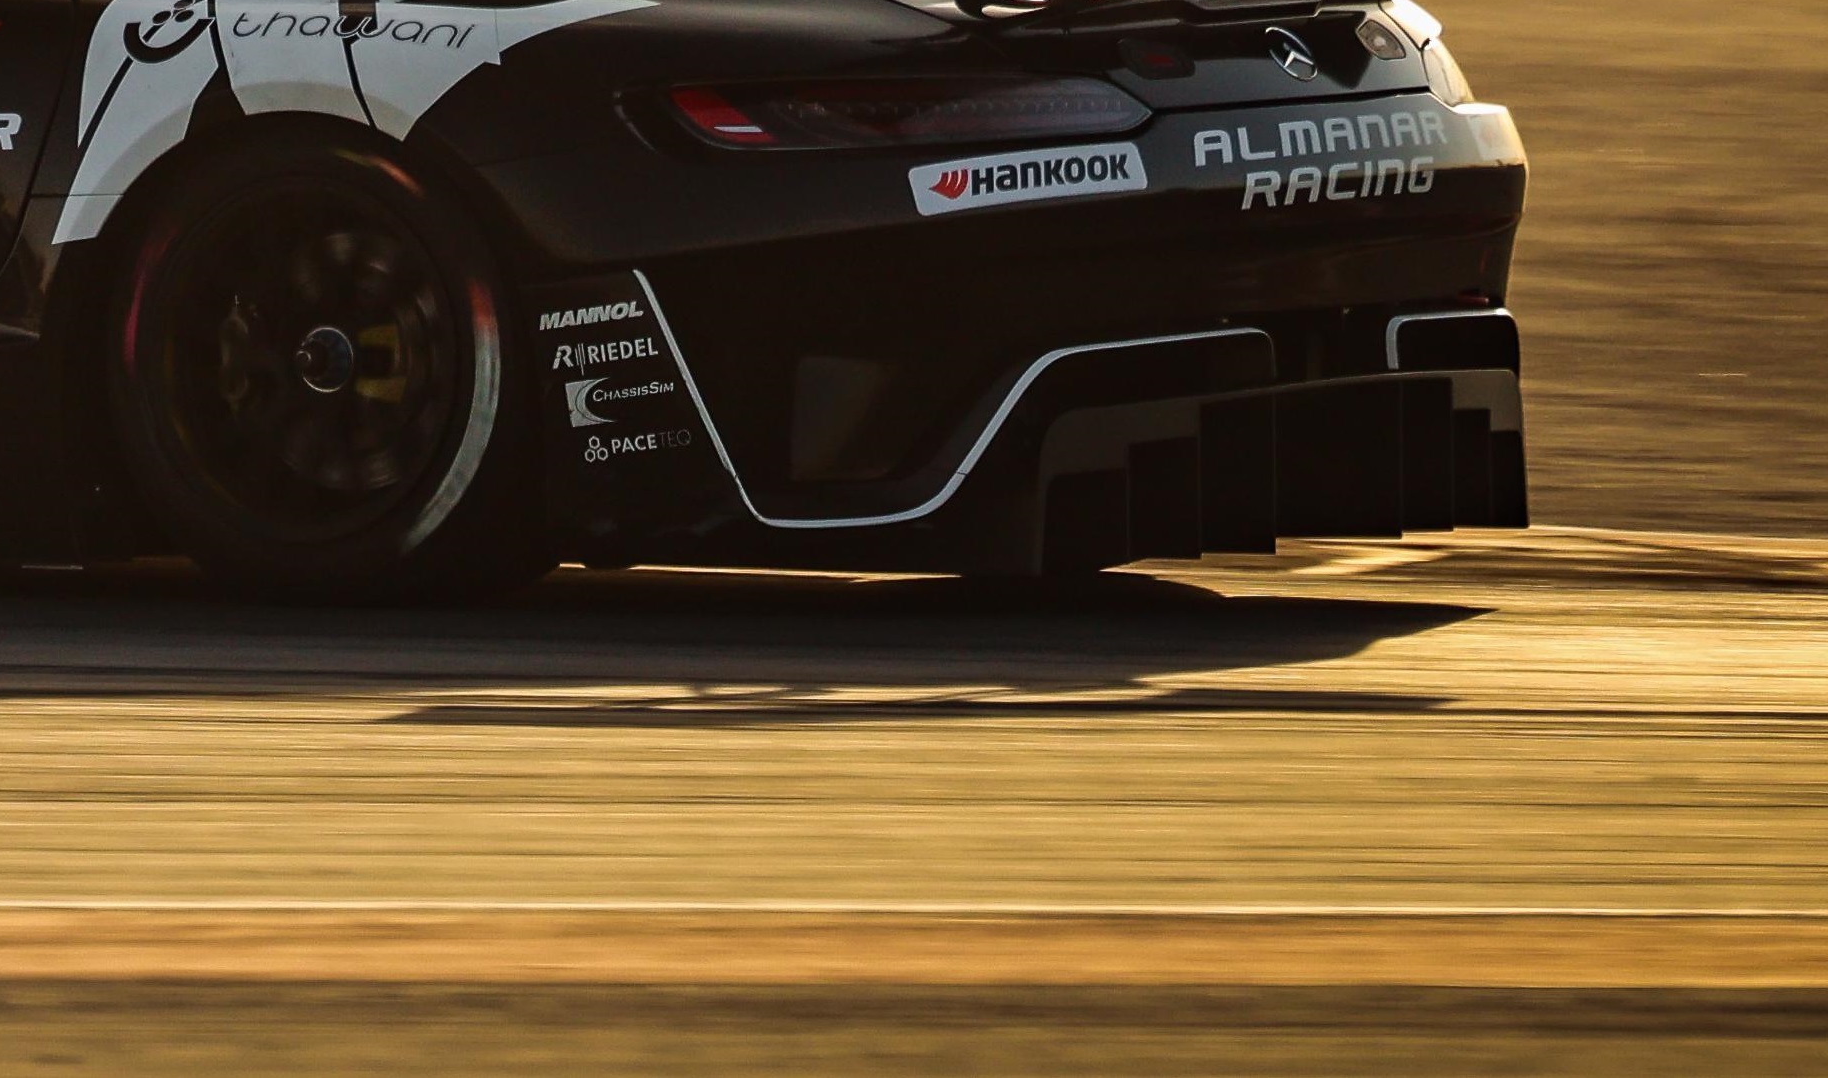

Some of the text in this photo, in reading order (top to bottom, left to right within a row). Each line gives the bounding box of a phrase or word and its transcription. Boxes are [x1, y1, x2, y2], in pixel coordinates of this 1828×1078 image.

[231, 11, 477, 49] thawani
[1193, 110, 1449, 168] ALMANAR
[1240, 155, 1436, 211] RACING
[539, 300, 644, 331] MANNOL
[587, 336, 659, 365] RIEDEL
